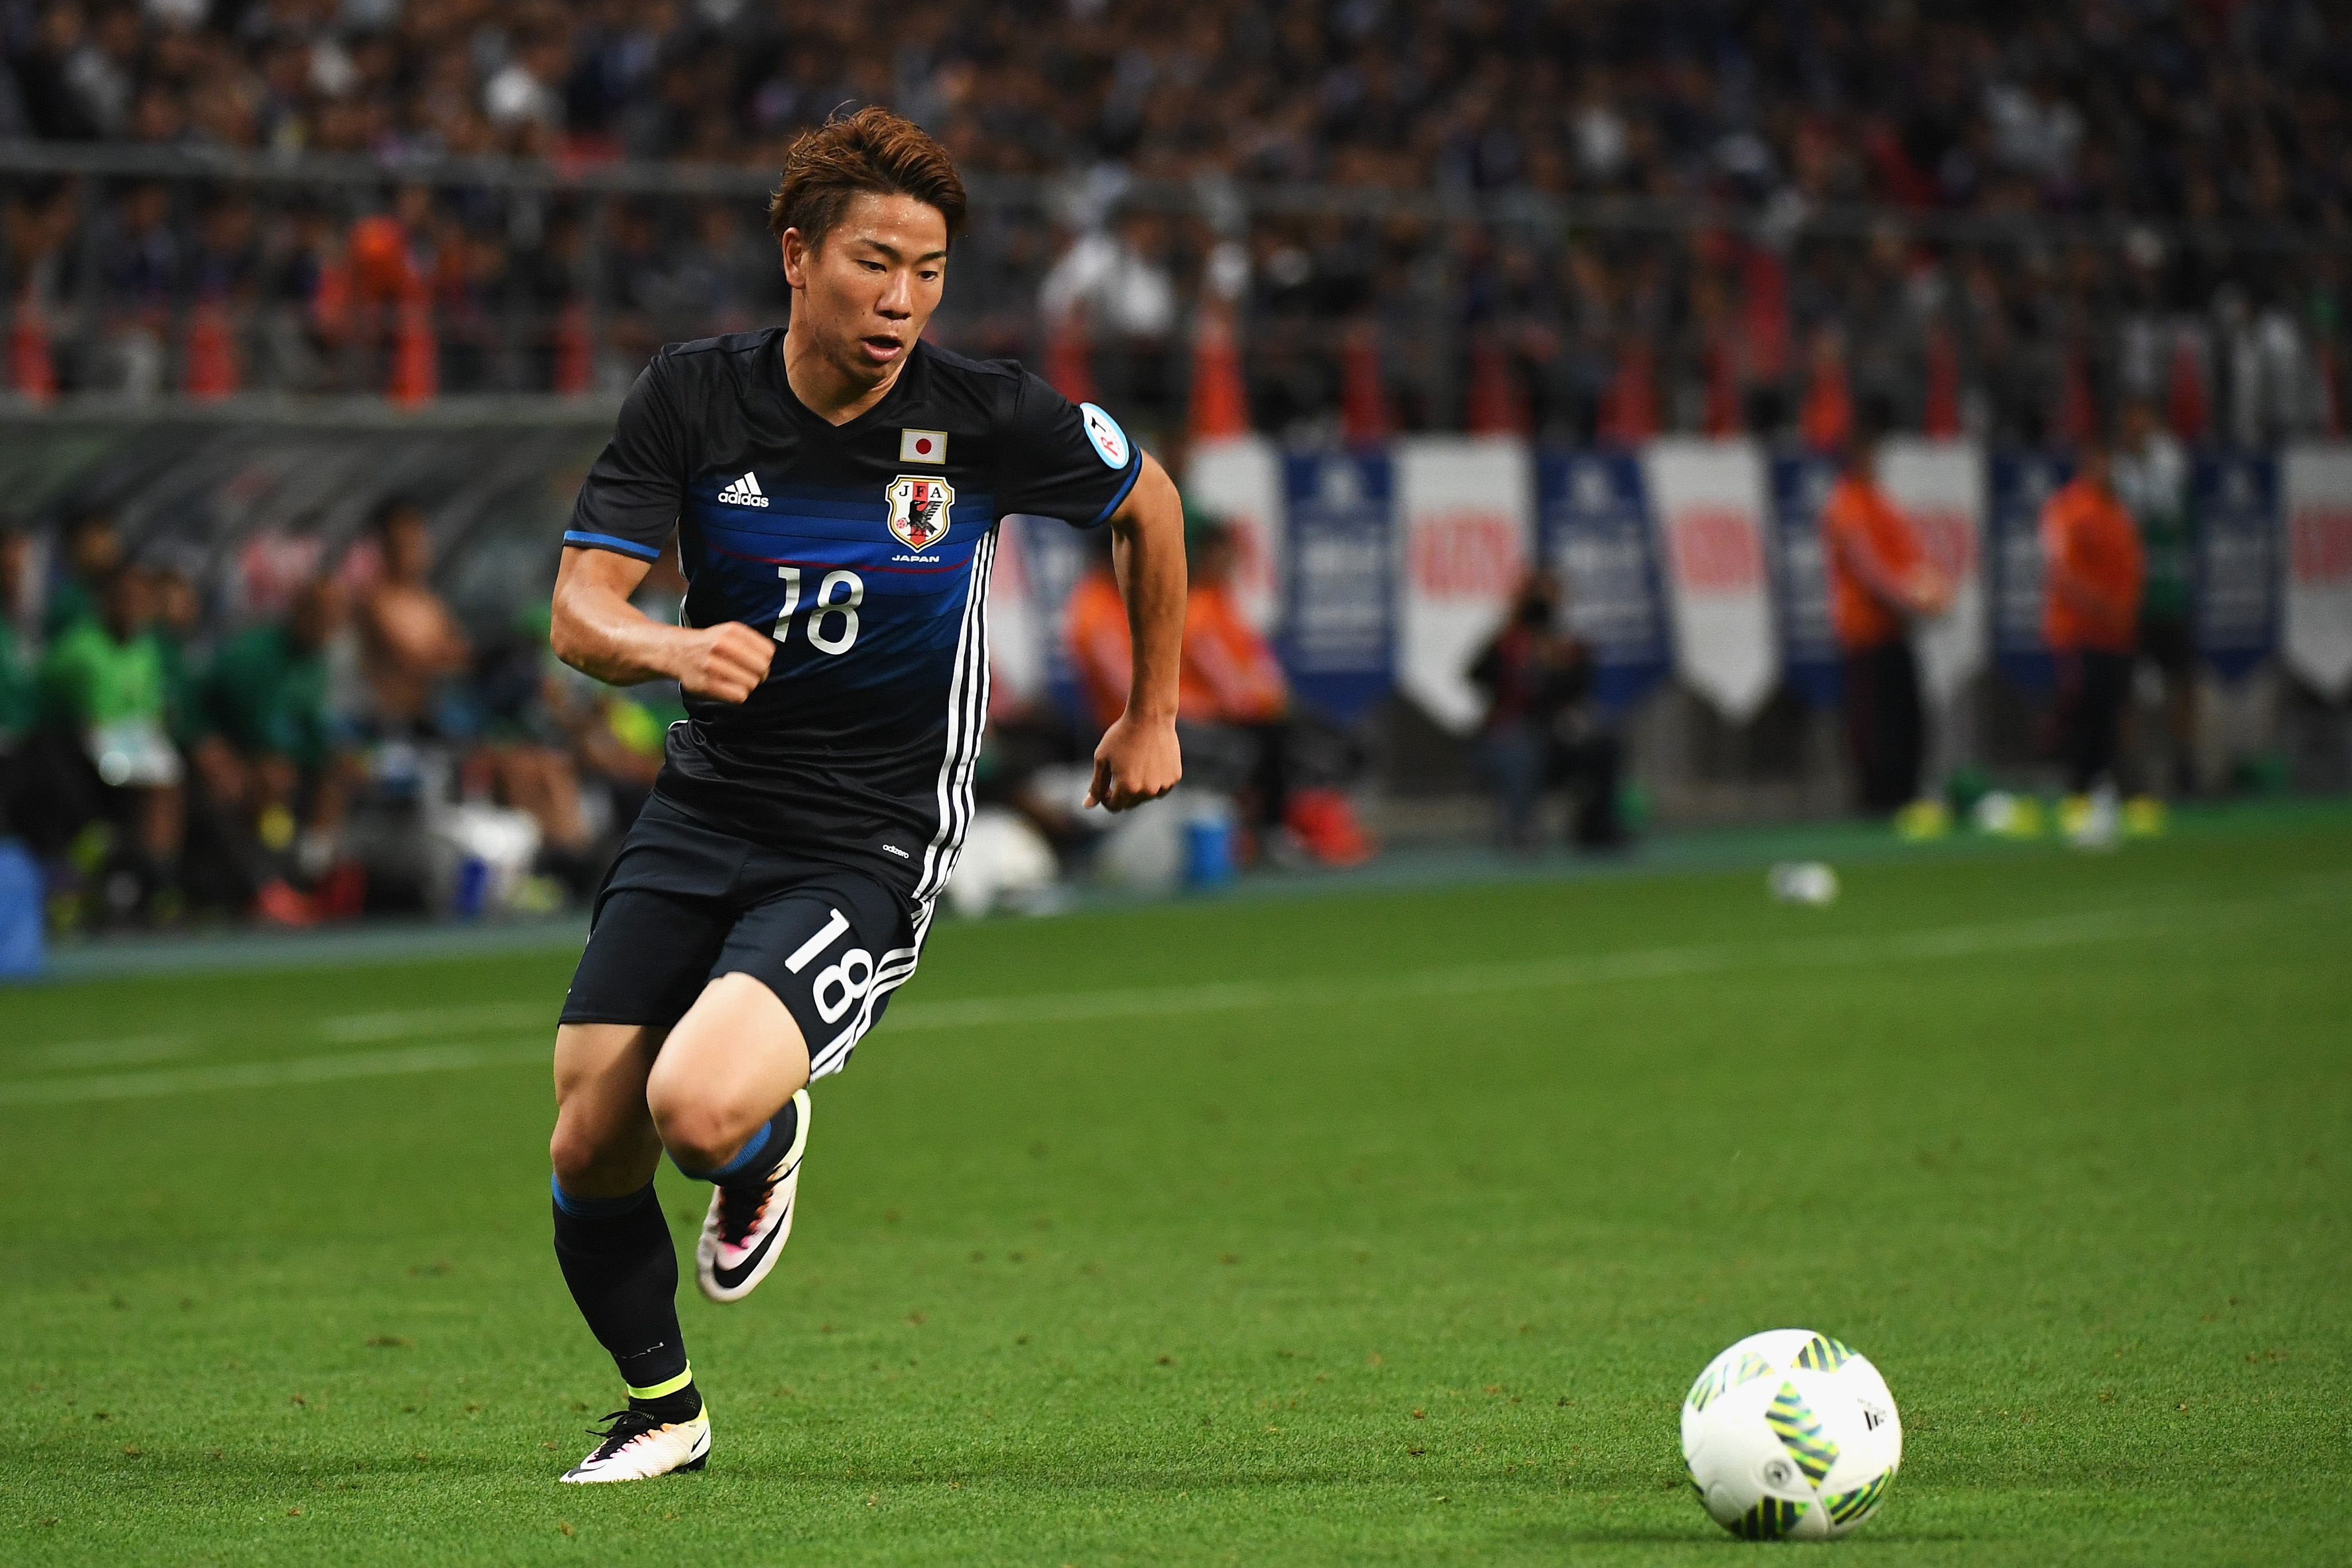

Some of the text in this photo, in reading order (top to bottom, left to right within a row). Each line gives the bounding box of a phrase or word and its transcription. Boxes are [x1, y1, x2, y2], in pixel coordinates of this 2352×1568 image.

[899, 485, 943, 498] JFA
[718, 492, 769, 508] adidas
[773, 567, 864, 655] 18
[882, 844, 909, 858] adizero
[785, 908, 873, 1024] 18
